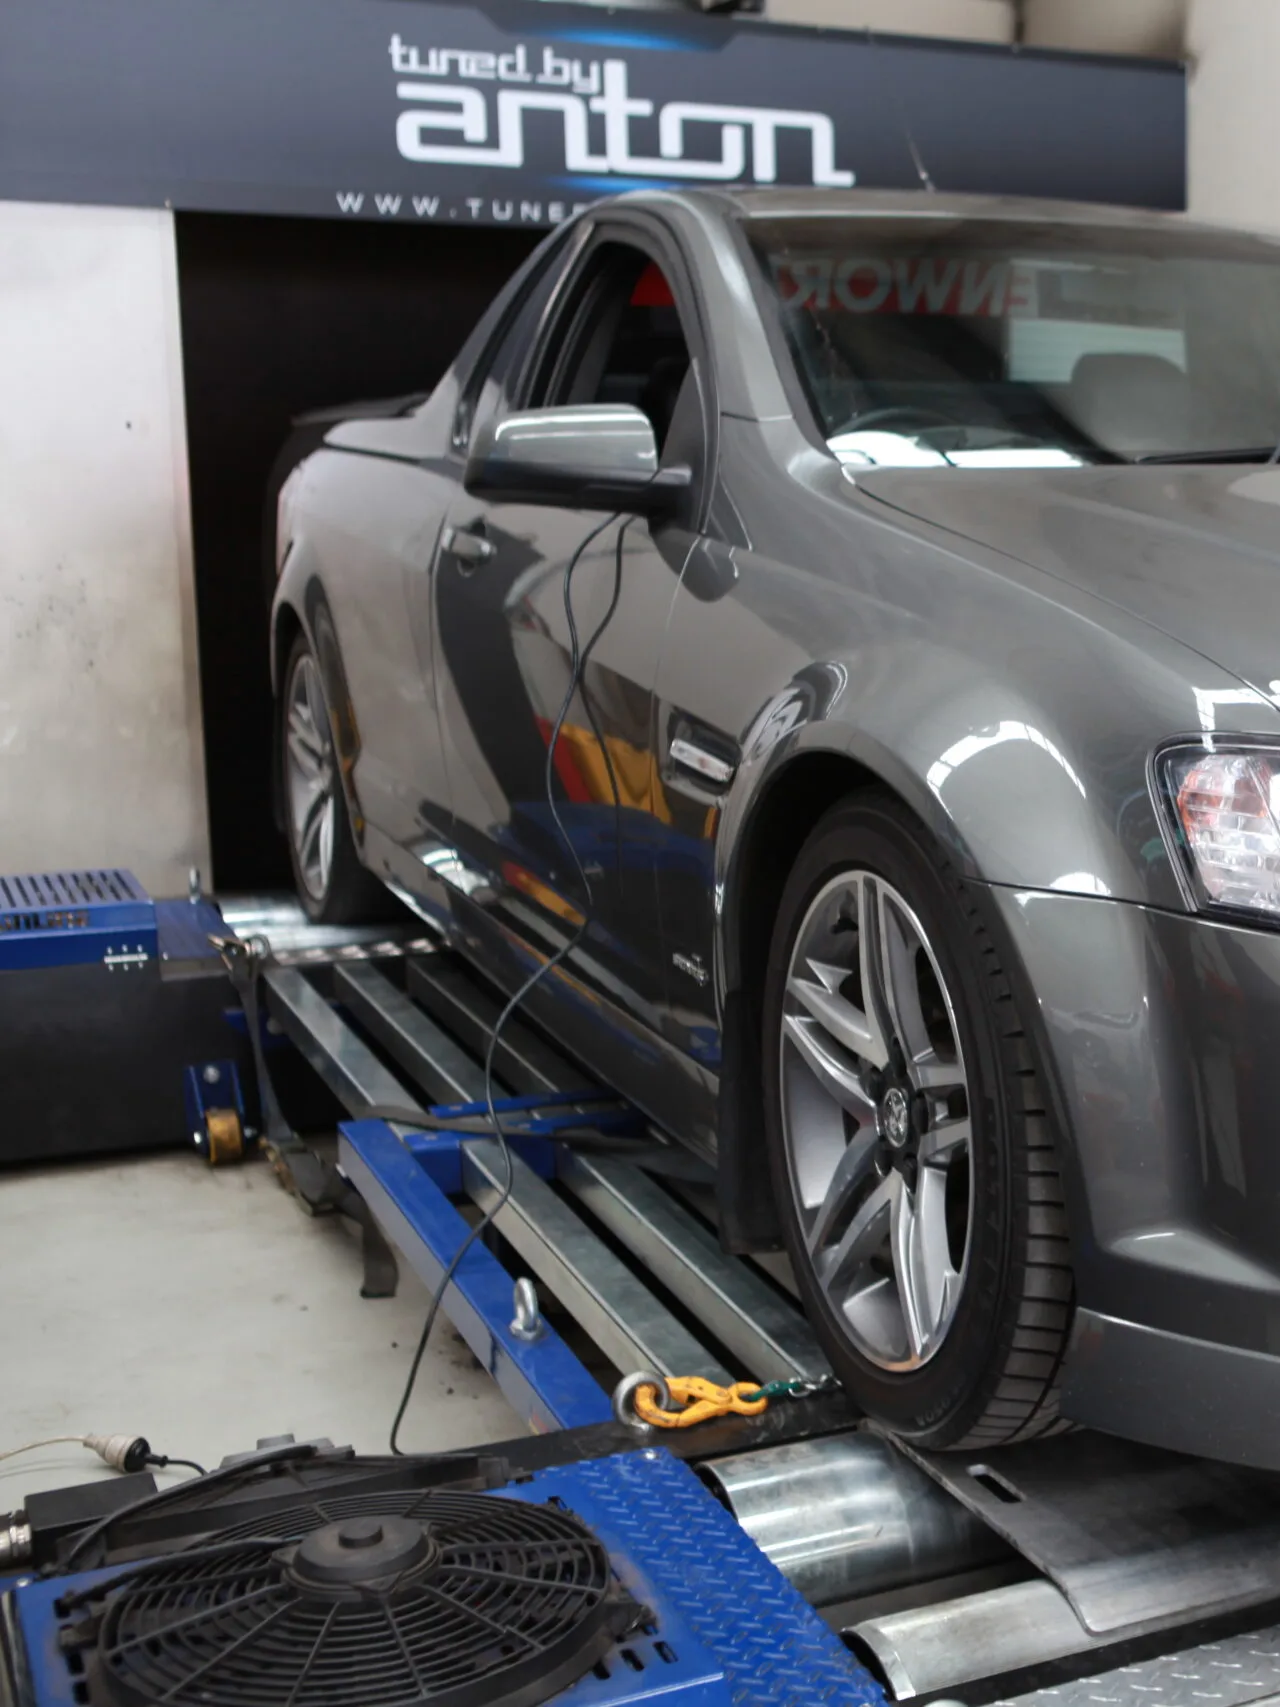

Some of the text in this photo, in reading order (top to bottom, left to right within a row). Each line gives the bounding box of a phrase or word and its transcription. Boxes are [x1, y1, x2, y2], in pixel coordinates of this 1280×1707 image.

[389, 33, 599, 93] tuned by
[396, 59, 854, 187] anton
